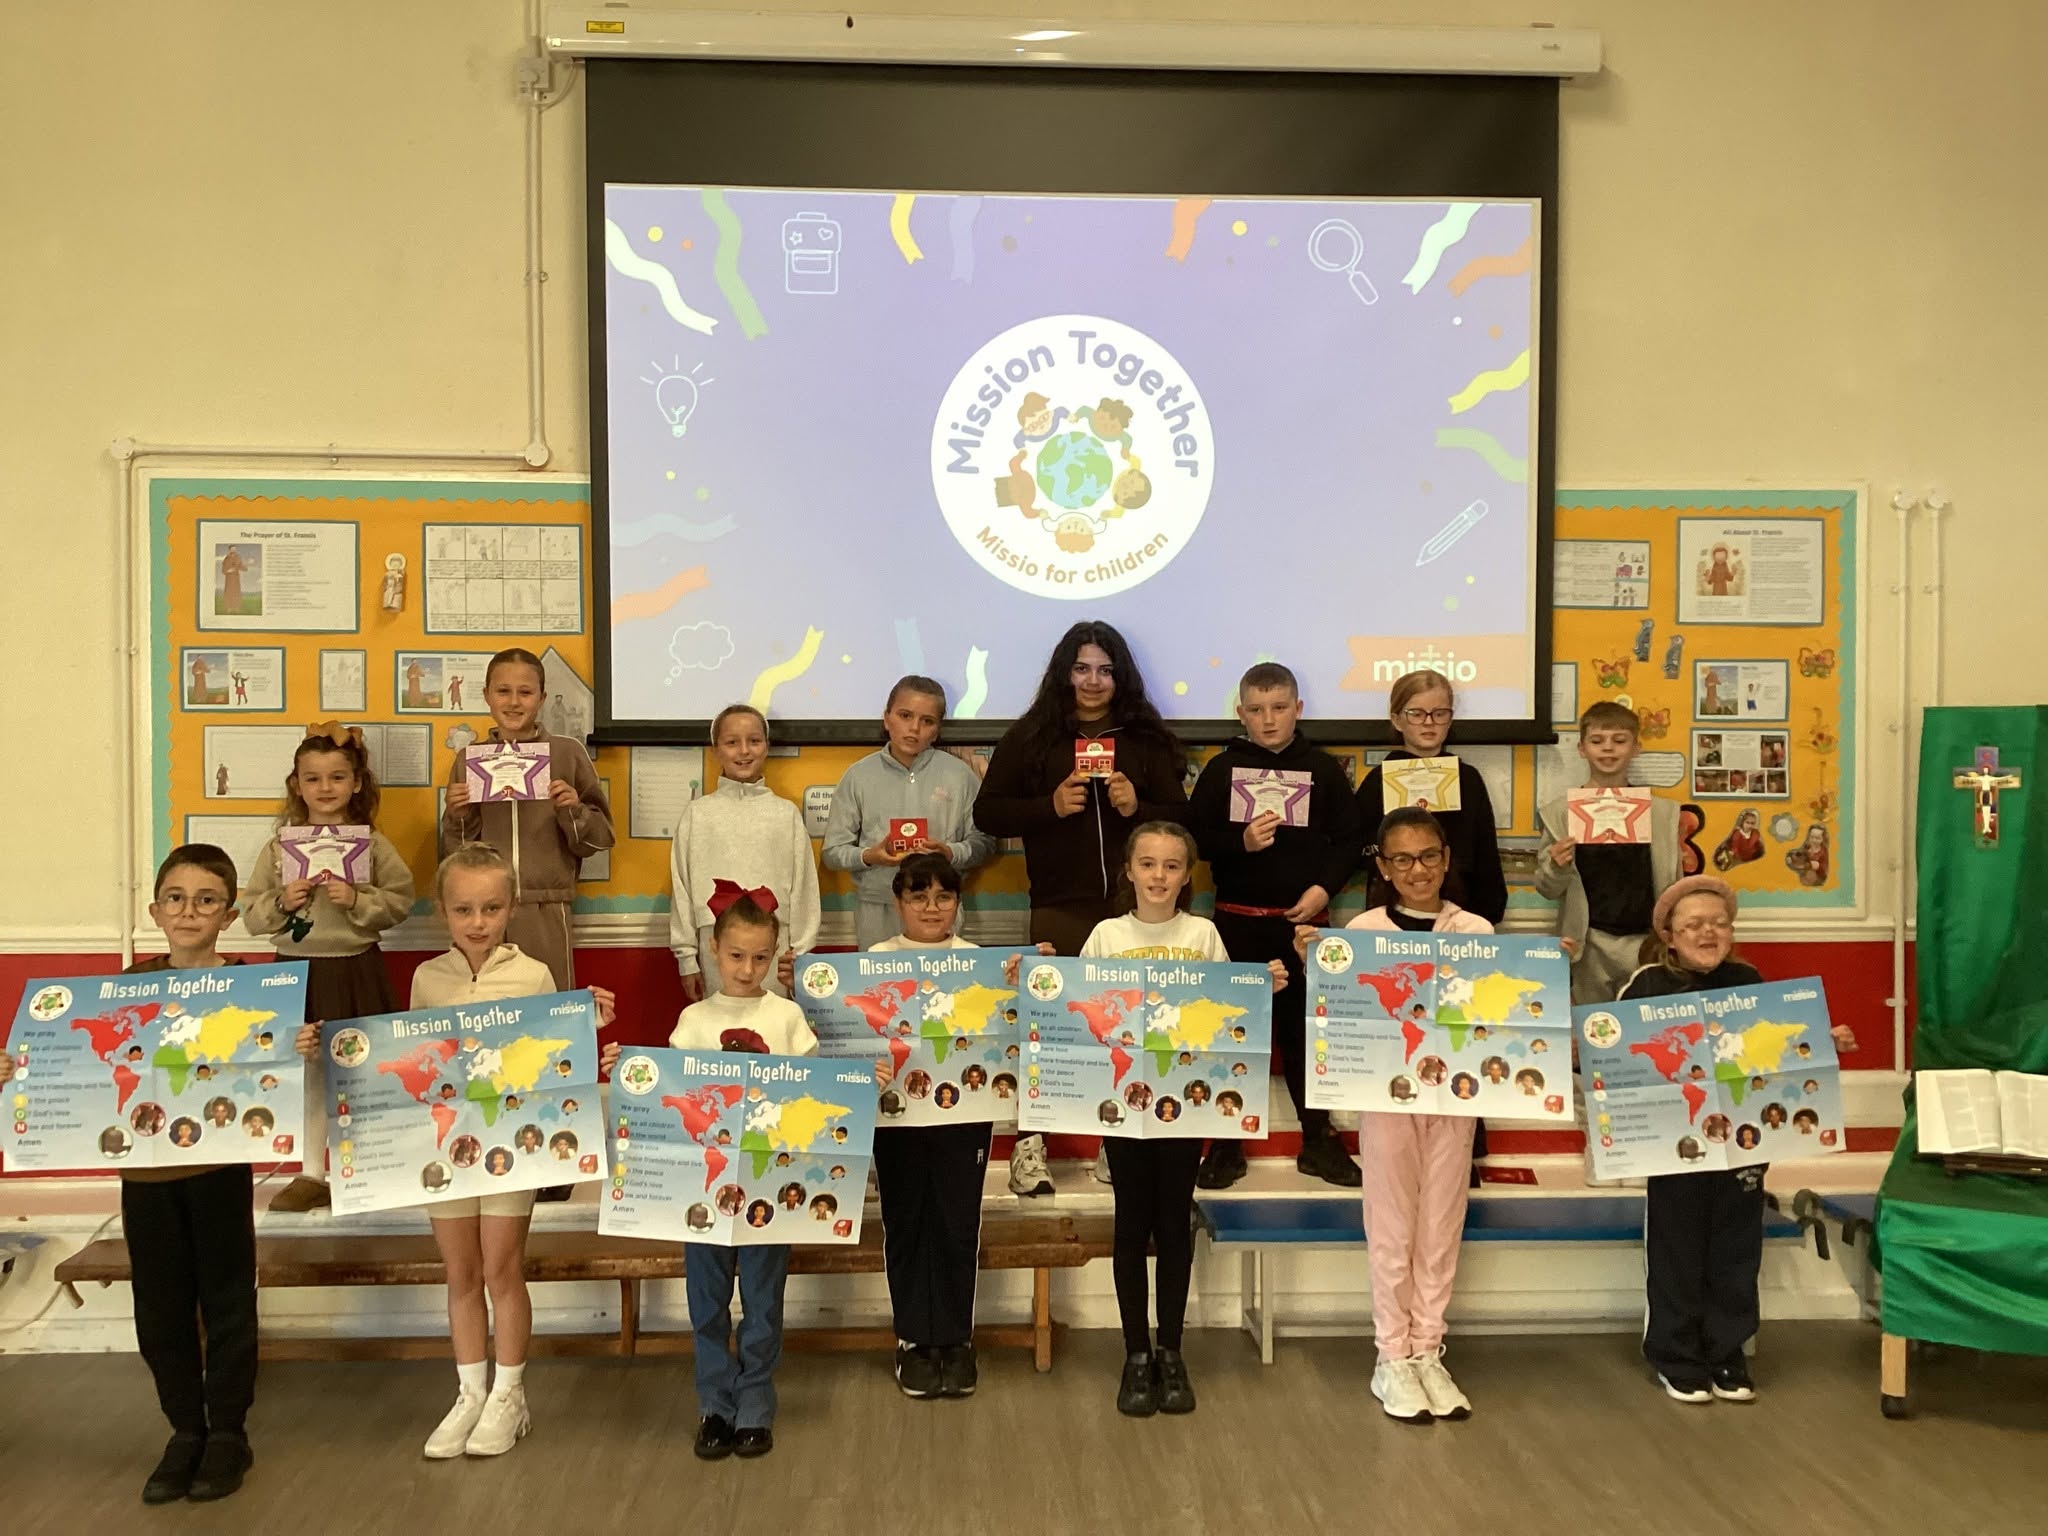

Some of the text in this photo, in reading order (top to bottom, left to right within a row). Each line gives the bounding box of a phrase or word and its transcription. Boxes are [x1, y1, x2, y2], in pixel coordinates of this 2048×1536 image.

[947, 330, 1198, 477] Mission Together
[976, 526, 1168, 584] Missio for children
[807, 803, 829, 811] world
[811, 791, 820, 799] All
[1375, 936, 1431, 956] Mission
[1436, 939, 1500, 962] Together
[859, 957, 912, 976] Mission
[917, 953, 977, 977] Together
[1085, 963, 1265, 988] Mission Together missio
[99, 972, 299, 1000] Mission Together missio
[392, 1002, 586, 1038] Mission Together missio
[1639, 1003, 1697, 1023] Mission
[1701, 993, 1759, 1018] Together
[683, 1055, 871, 1084] Mission Together missio
[612, 1204, 635, 1213] Amen
